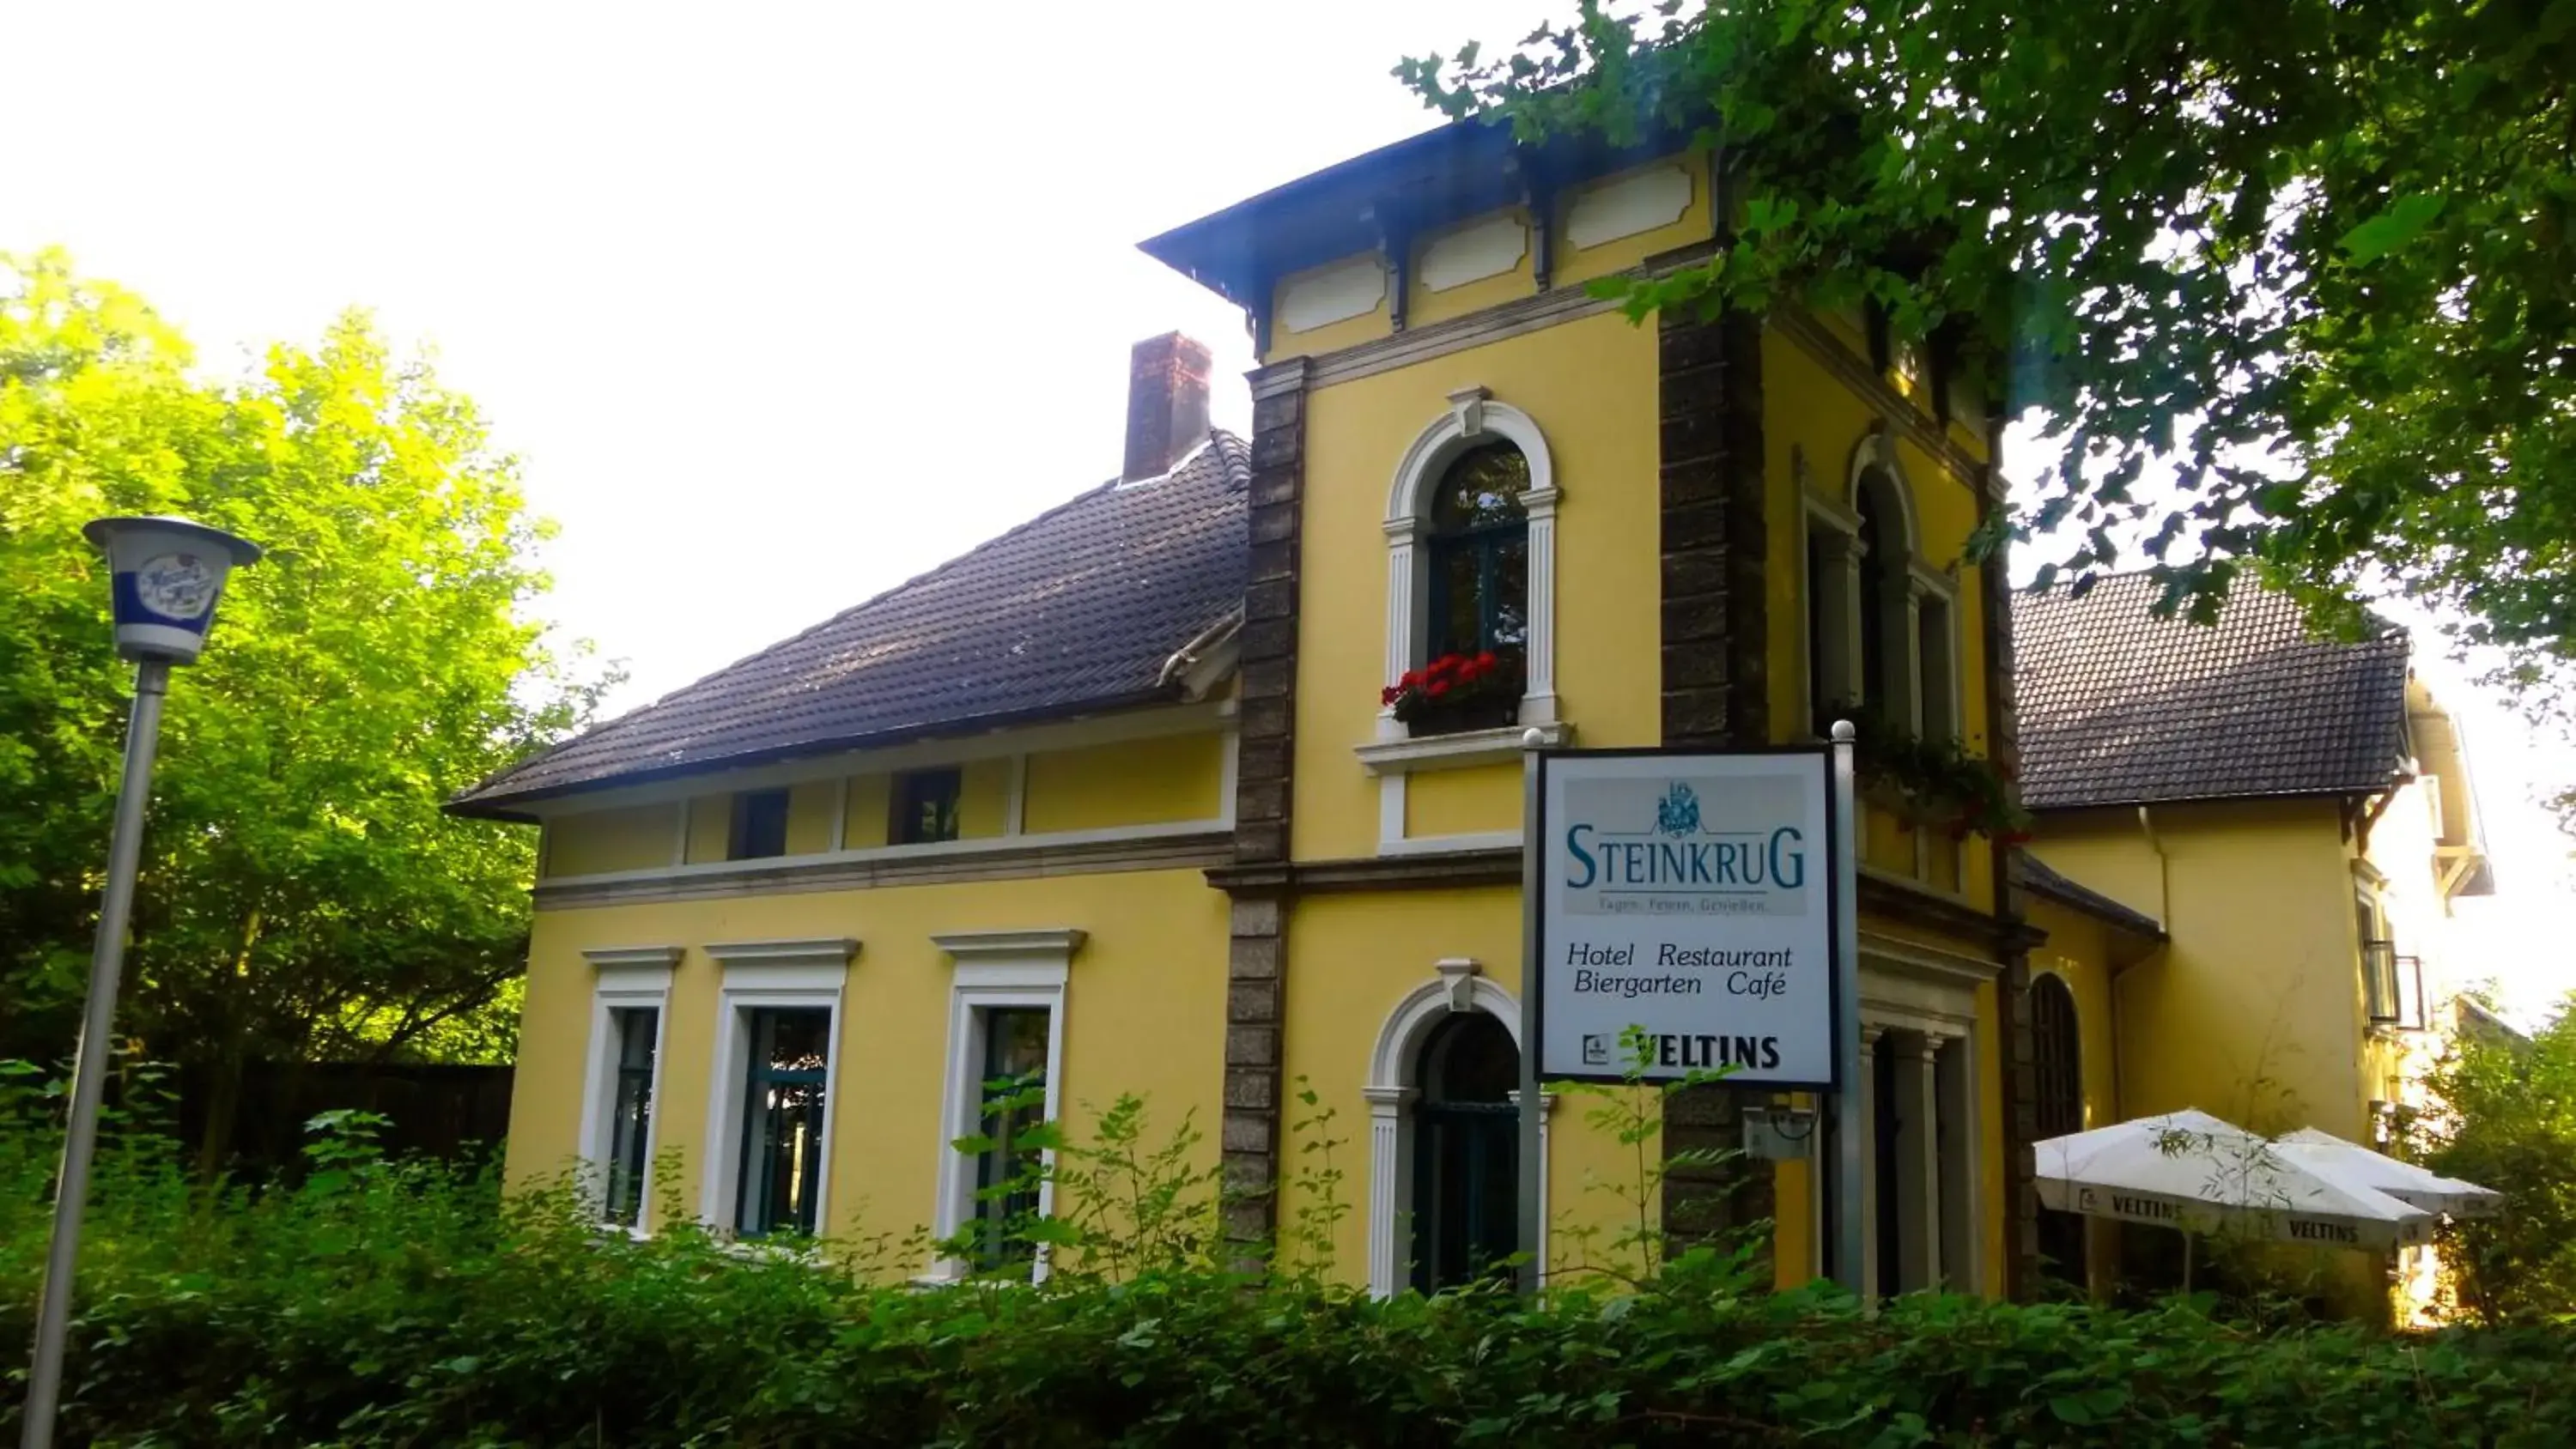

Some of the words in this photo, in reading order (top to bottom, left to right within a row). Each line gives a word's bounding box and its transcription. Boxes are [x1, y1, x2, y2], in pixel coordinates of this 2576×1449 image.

[1567, 824, 1804, 888] STEINKRUG
[1567, 943, 1635, 966] Hotel
[1658, 943, 1794, 967] Restaurant
[1574, 969, 1702, 998] Biergarten
[1727, 971, 1787, 1000] Café
[2289, 1220, 2360, 1243] VELTINS
